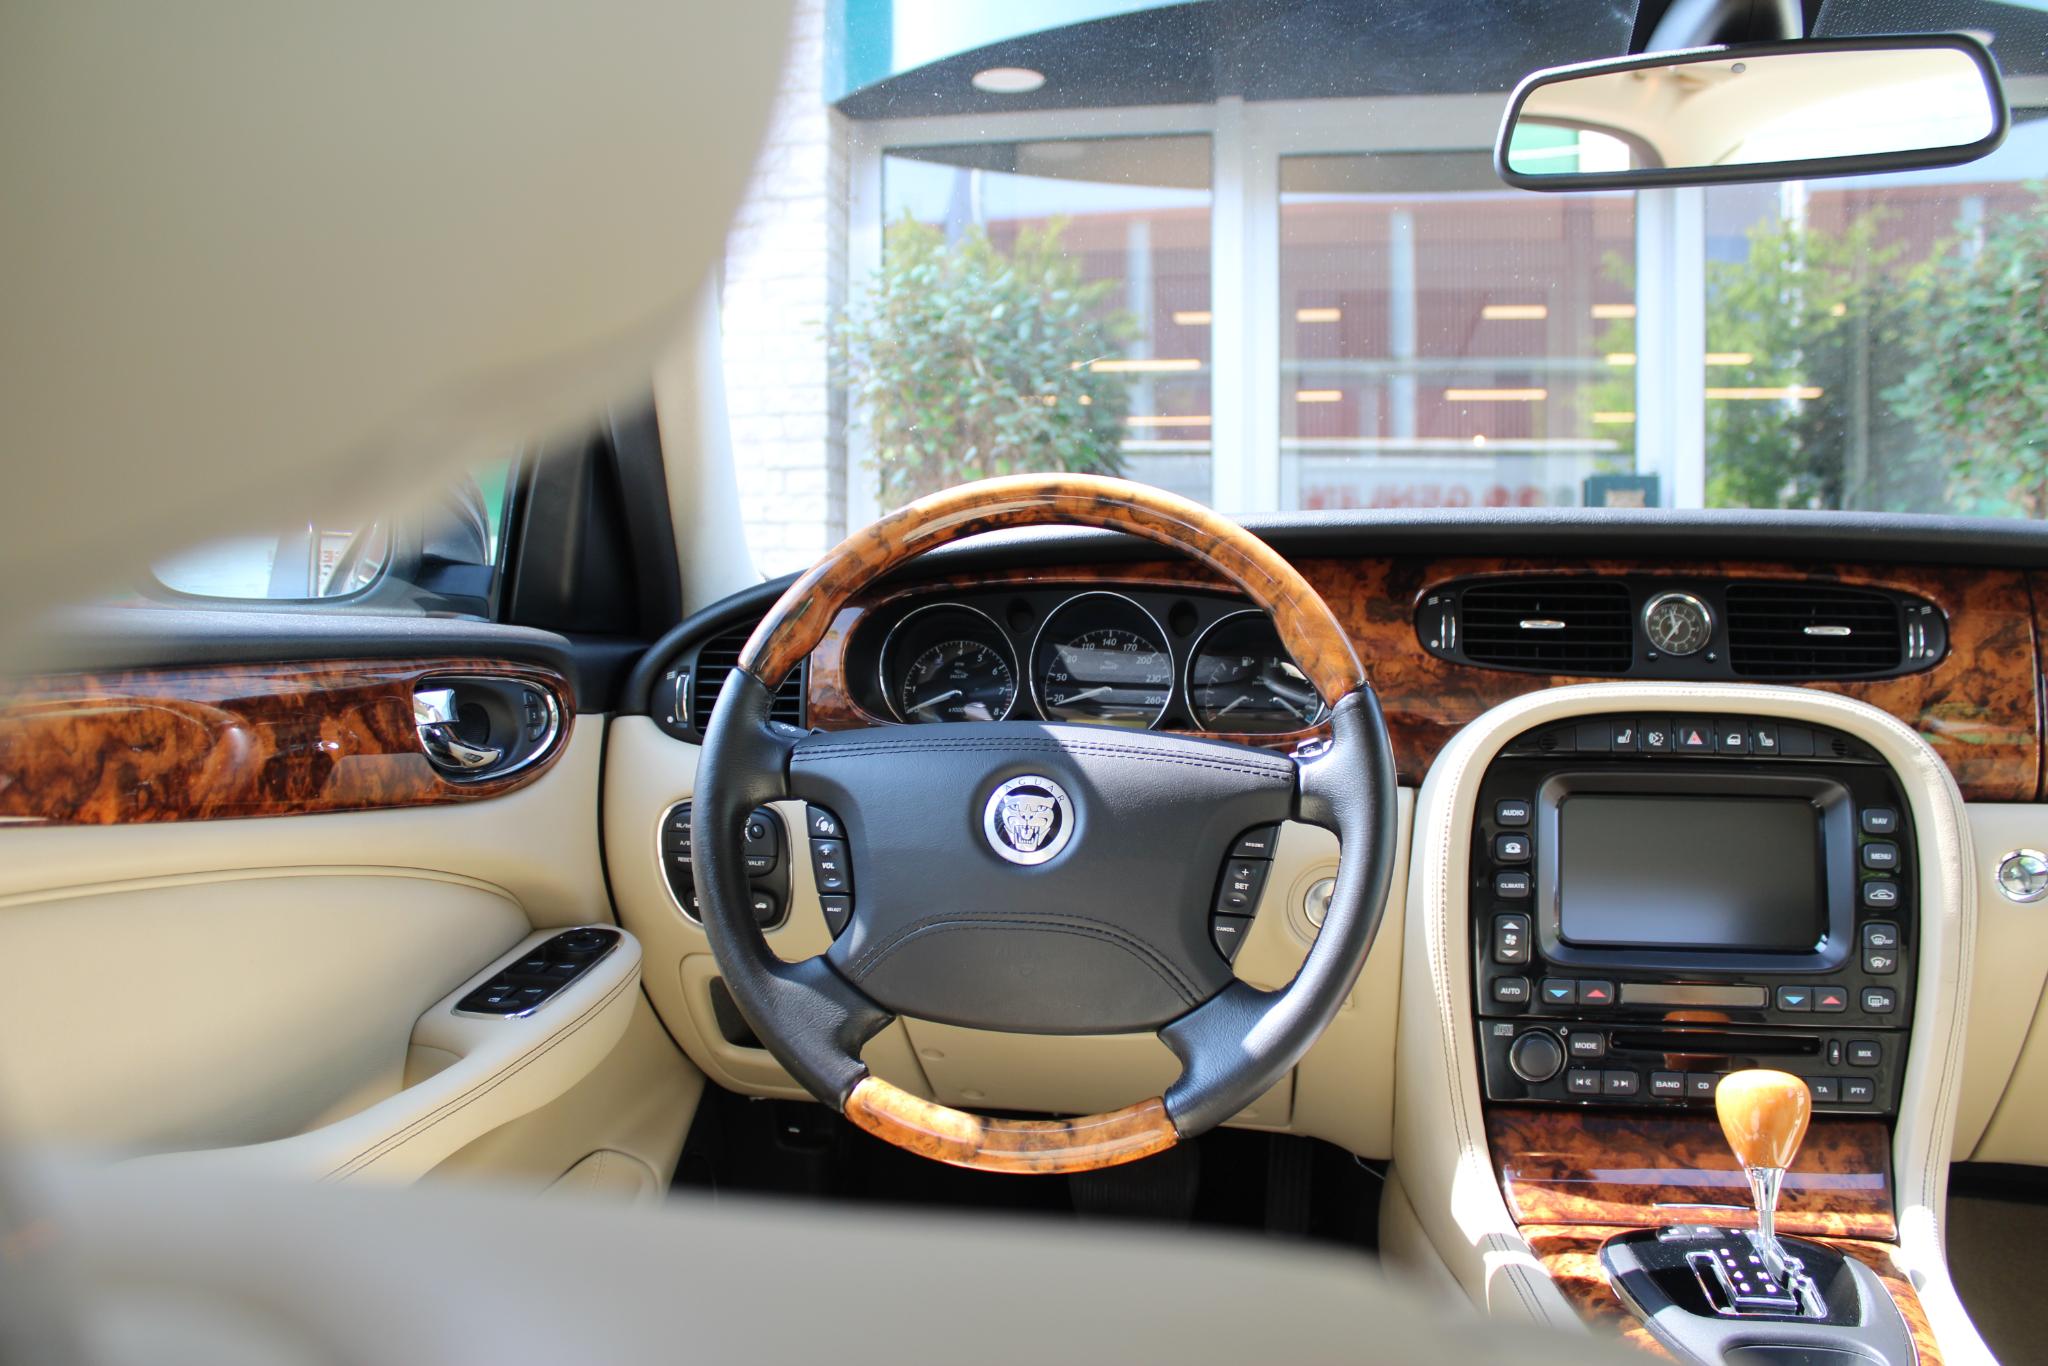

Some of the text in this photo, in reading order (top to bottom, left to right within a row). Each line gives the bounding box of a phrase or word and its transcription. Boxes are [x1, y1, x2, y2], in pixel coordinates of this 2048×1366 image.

[1102, 638, 1117, 647] 140
[1081, 643, 1095, 651] 110
[1123, 643, 1138, 652] 170
[1066, 655, 1078, 663] 80
[1136, 656, 1152, 665] 200
[920, 666, 927, 674] 2
[992, 667, 998, 675] 6
[1056, 673, 1067, 681] 50
[1145, 674, 1161, 683] 230
[911, 685, 916, 693] 1
[999, 687, 1005, 695] 7
[1053, 694, 1064, 702] 20
[1144, 696, 1161, 705] 260
[993, 707, 999, 715] 8
[1502, 809, 1525, 817] AUDIO
[1871, 817, 1888, 825] NAV
[1870, 852, 1891, 860] MENU
[1234, 882, 1249, 890] SET
[1500, 987, 1521, 995] AUTO
[1883, 998, 1890, 1006] R
[1574, 1042, 1597, 1050] MODE
[1656, 1081, 1680, 1089] BAND
[1697, 1082, 1710, 1090] CD
